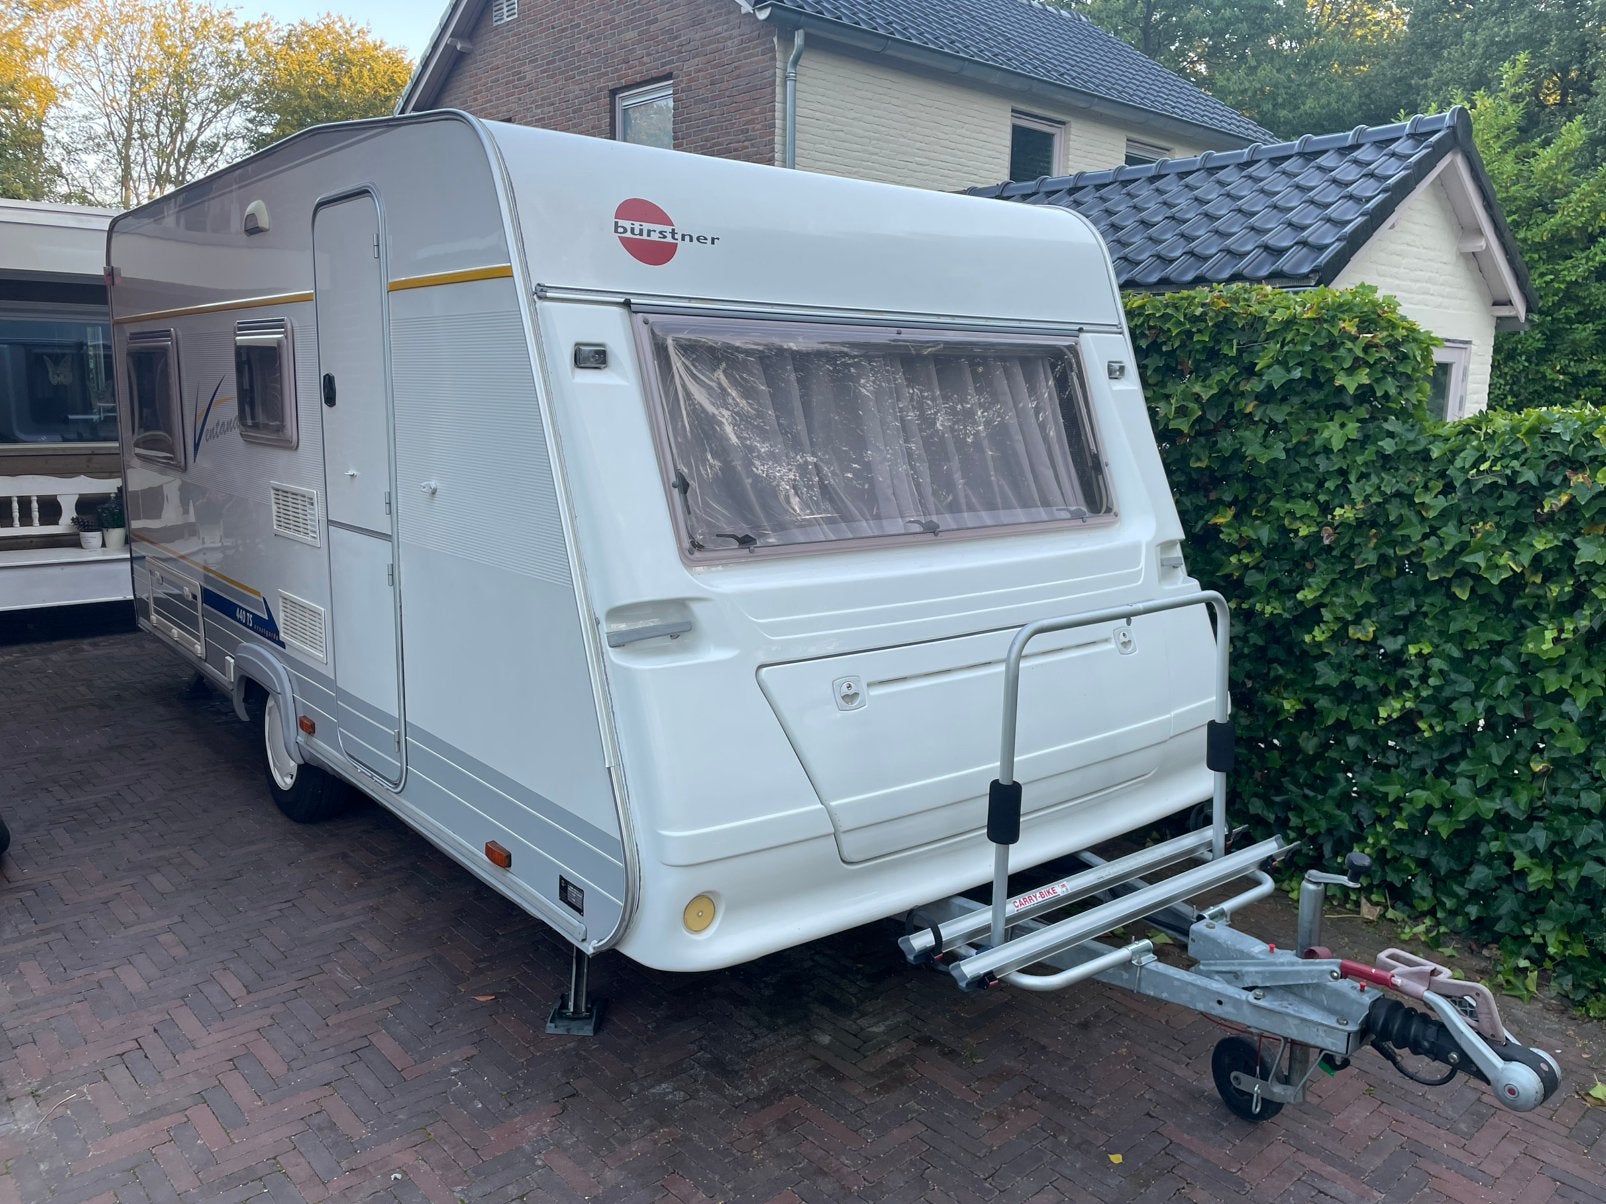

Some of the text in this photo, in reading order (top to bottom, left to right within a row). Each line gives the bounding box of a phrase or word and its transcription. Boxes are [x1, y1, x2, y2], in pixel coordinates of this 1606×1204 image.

[613, 220, 720, 245] bürstner
[236, 607, 246, 623] 440
[247, 612, 253, 627] TS
[1012, 886, 1058, 909] CARRY-BIKE
